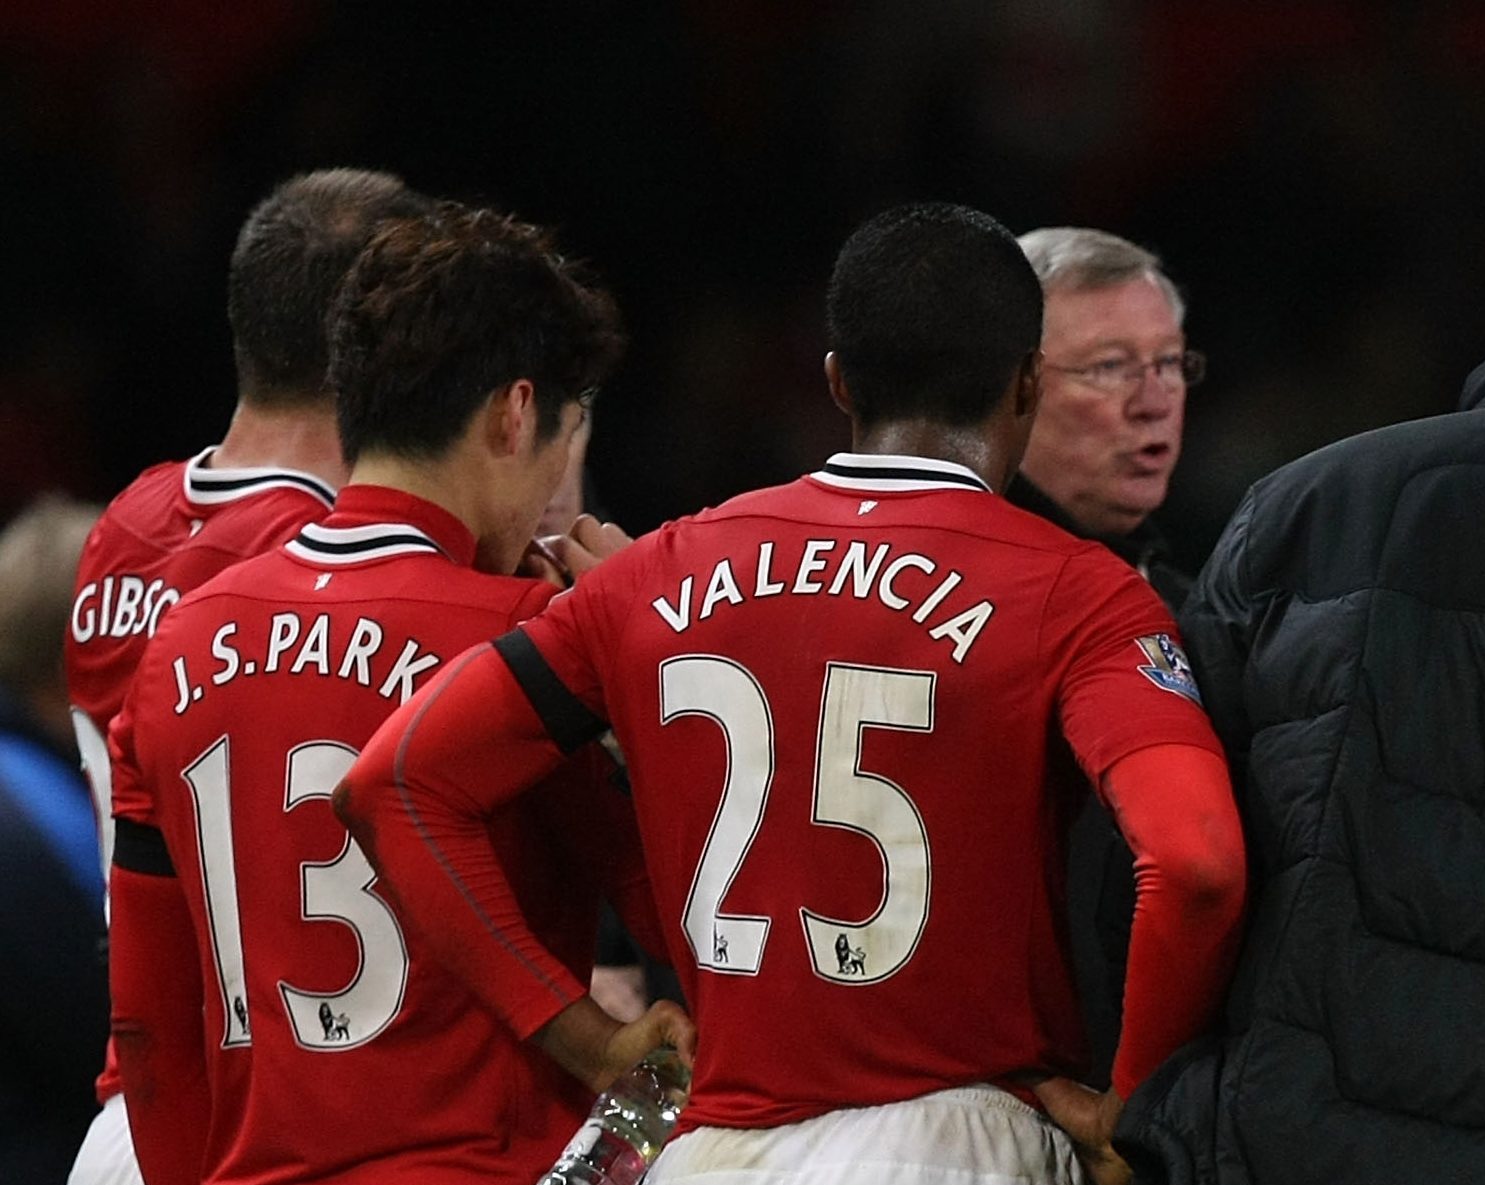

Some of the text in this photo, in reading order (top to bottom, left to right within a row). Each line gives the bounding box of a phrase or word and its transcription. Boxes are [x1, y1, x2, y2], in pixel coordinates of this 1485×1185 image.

[652, 539, 995, 663] VALENCIA
[180, 734, 410, 1052] 13
[659, 653, 938, 986] 25
